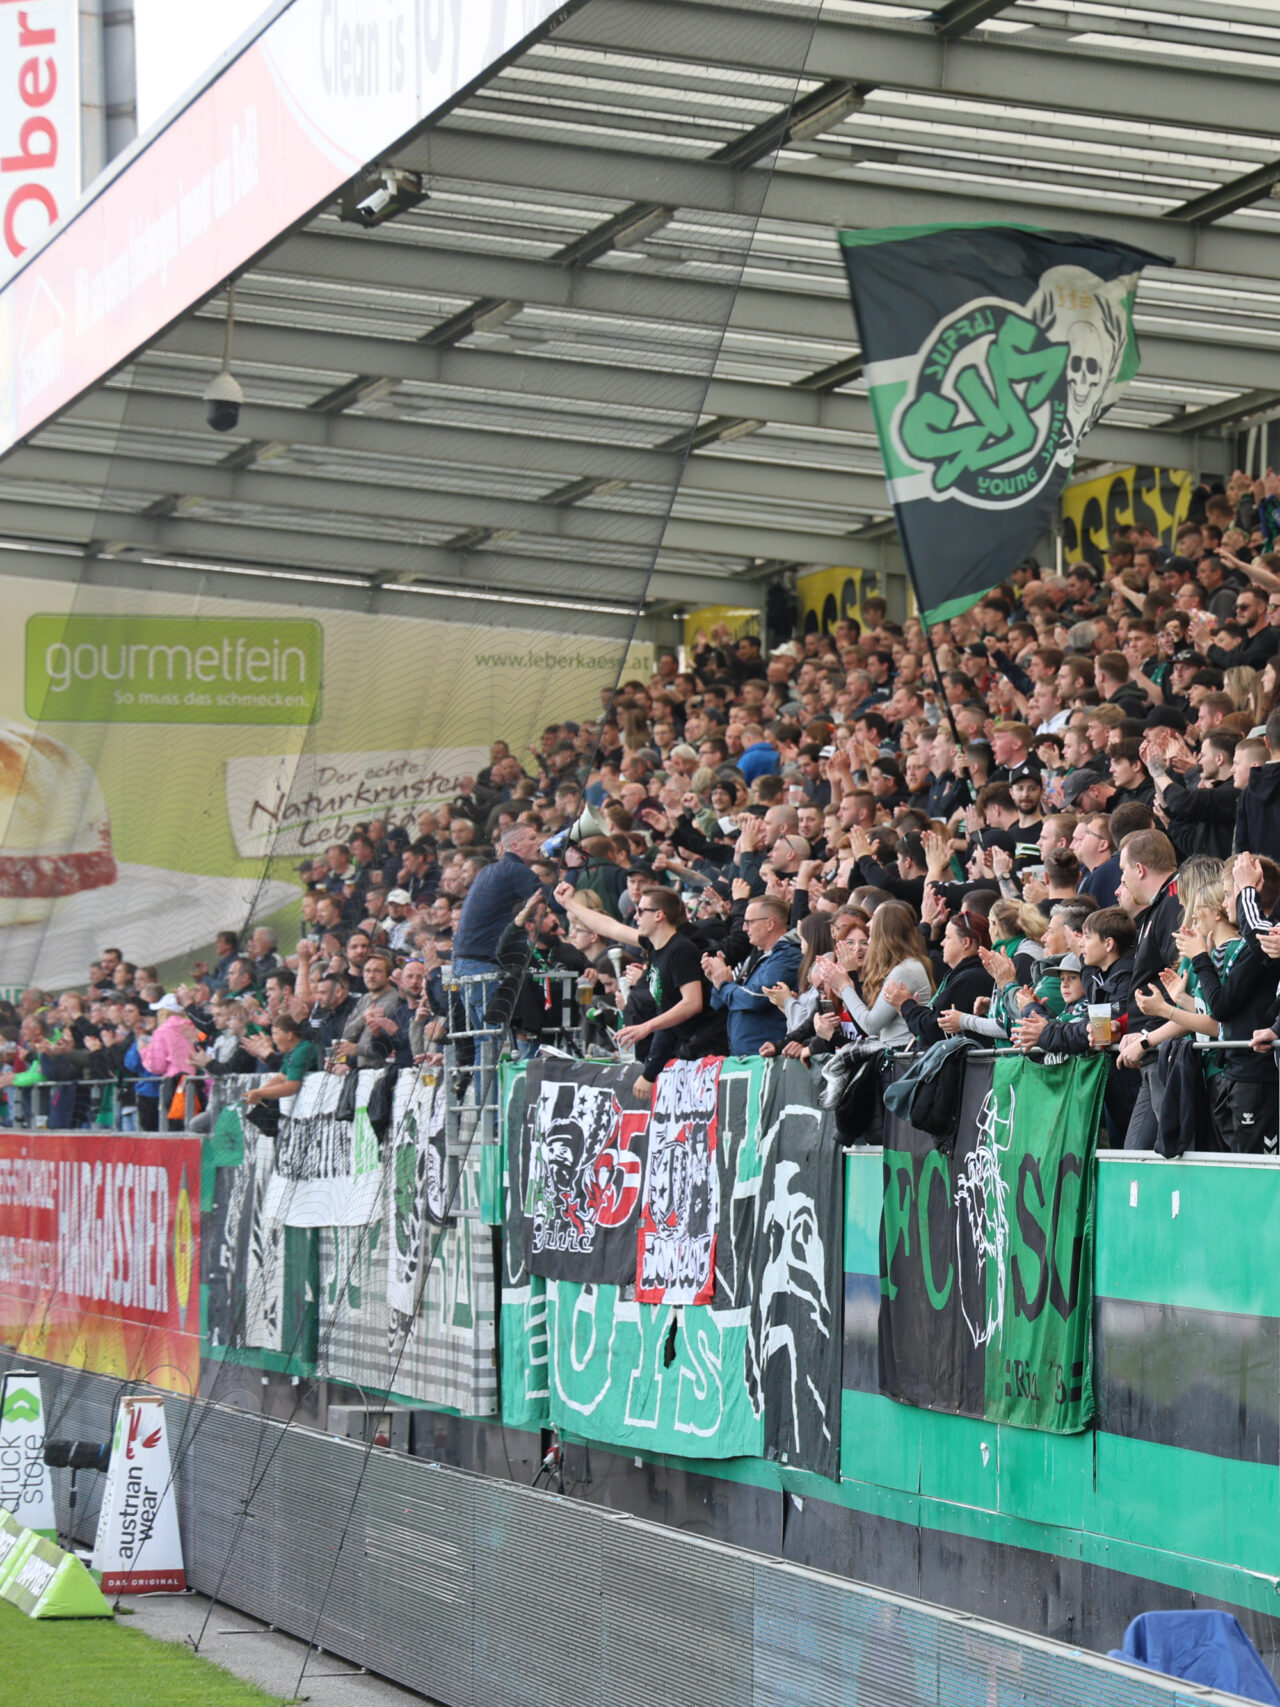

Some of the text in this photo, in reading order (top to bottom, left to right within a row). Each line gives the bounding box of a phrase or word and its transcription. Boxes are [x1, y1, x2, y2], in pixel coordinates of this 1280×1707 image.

[320, 0, 379, 96] Clean
[45, 637, 306, 692] gourmetfein
[113, 690, 134, 704] So
[139, 692, 180, 705] muss
[184, 691, 213, 706] das
[318, 759, 420, 787] Der echte
[58, 1159, 170, 1313] HARGASSNER
[21, 1434, 45, 1504] store
[119, 1466, 143, 1559] austrian
[139, 1486, 158, 1542] wear
[132, 1578, 179, 1586] ORIGINAL
